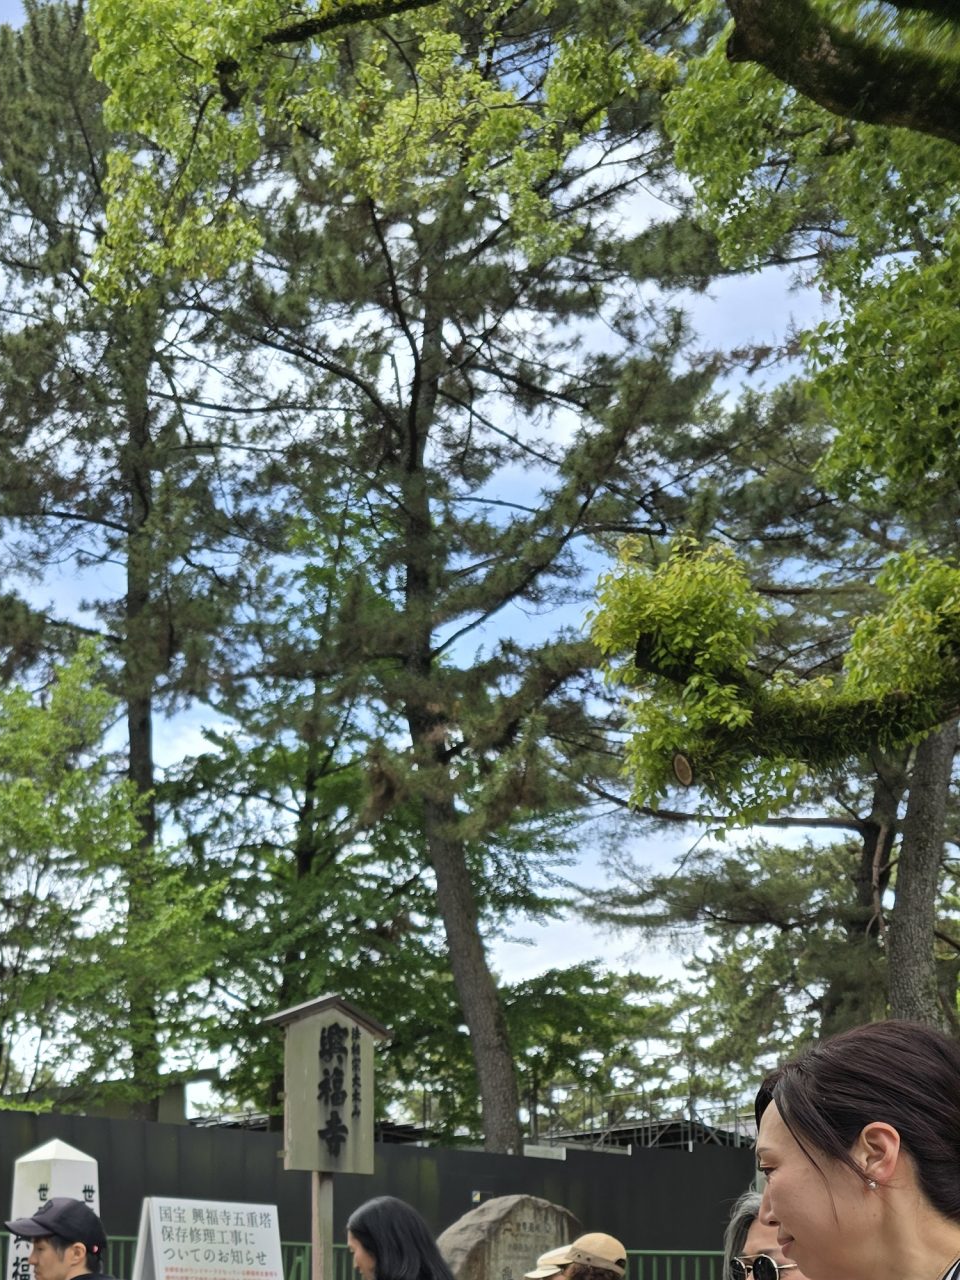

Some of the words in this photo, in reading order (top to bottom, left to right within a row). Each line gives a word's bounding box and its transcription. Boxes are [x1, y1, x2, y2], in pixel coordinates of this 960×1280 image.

[158, 1206, 187, 1224] 国宝
[191, 1207, 272, 1229] 興福寺五重塔
[161, 1226, 256, 1246] 保存修理工事に
[163, 1247, 268, 1266] ついてのお知らせ
